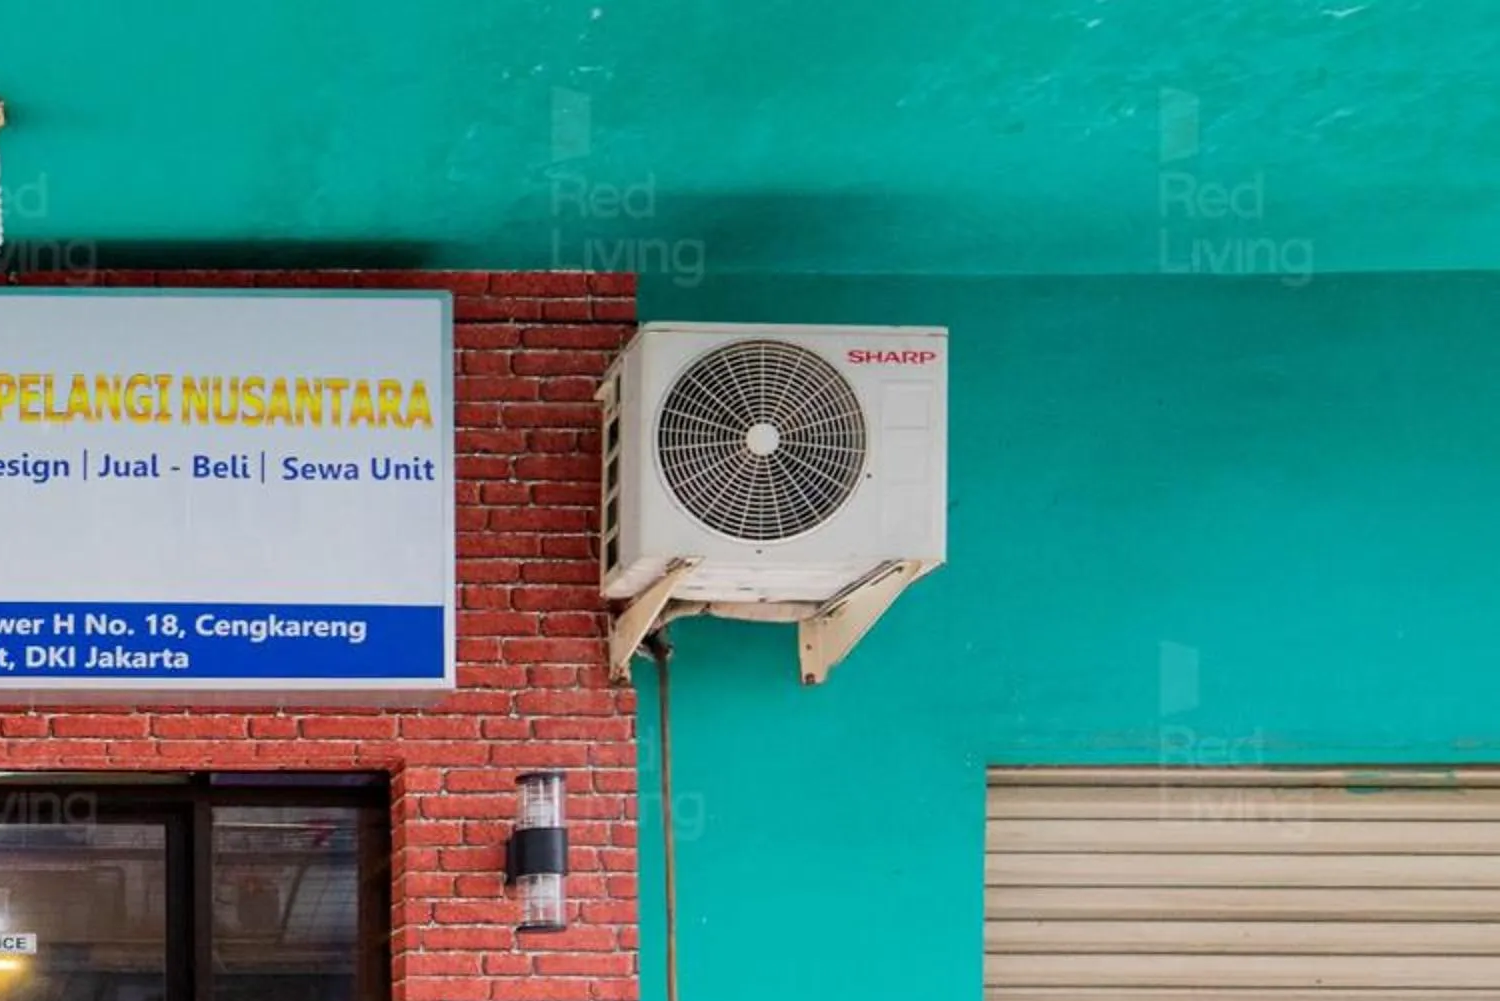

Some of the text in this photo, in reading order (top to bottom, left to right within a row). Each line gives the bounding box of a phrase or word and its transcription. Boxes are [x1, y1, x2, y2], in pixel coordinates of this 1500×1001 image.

[847, 350, 937, 363] SHARP
[181, 374, 433, 430] NUSANTARA
[98, 453, 160, 478] Jual
[193, 454, 251, 479] Beli
[282, 456, 360, 481] Sewa
[370, 456, 436, 481] Unit
[53, 614, 74, 635] H
[85, 614, 135, 635] No.
[145, 614, 186, 639] 18,
[195, 614, 367, 643] Cengkareng
[25, 646, 76, 668] DKI
[84, 646, 190, 669] Jakarta
